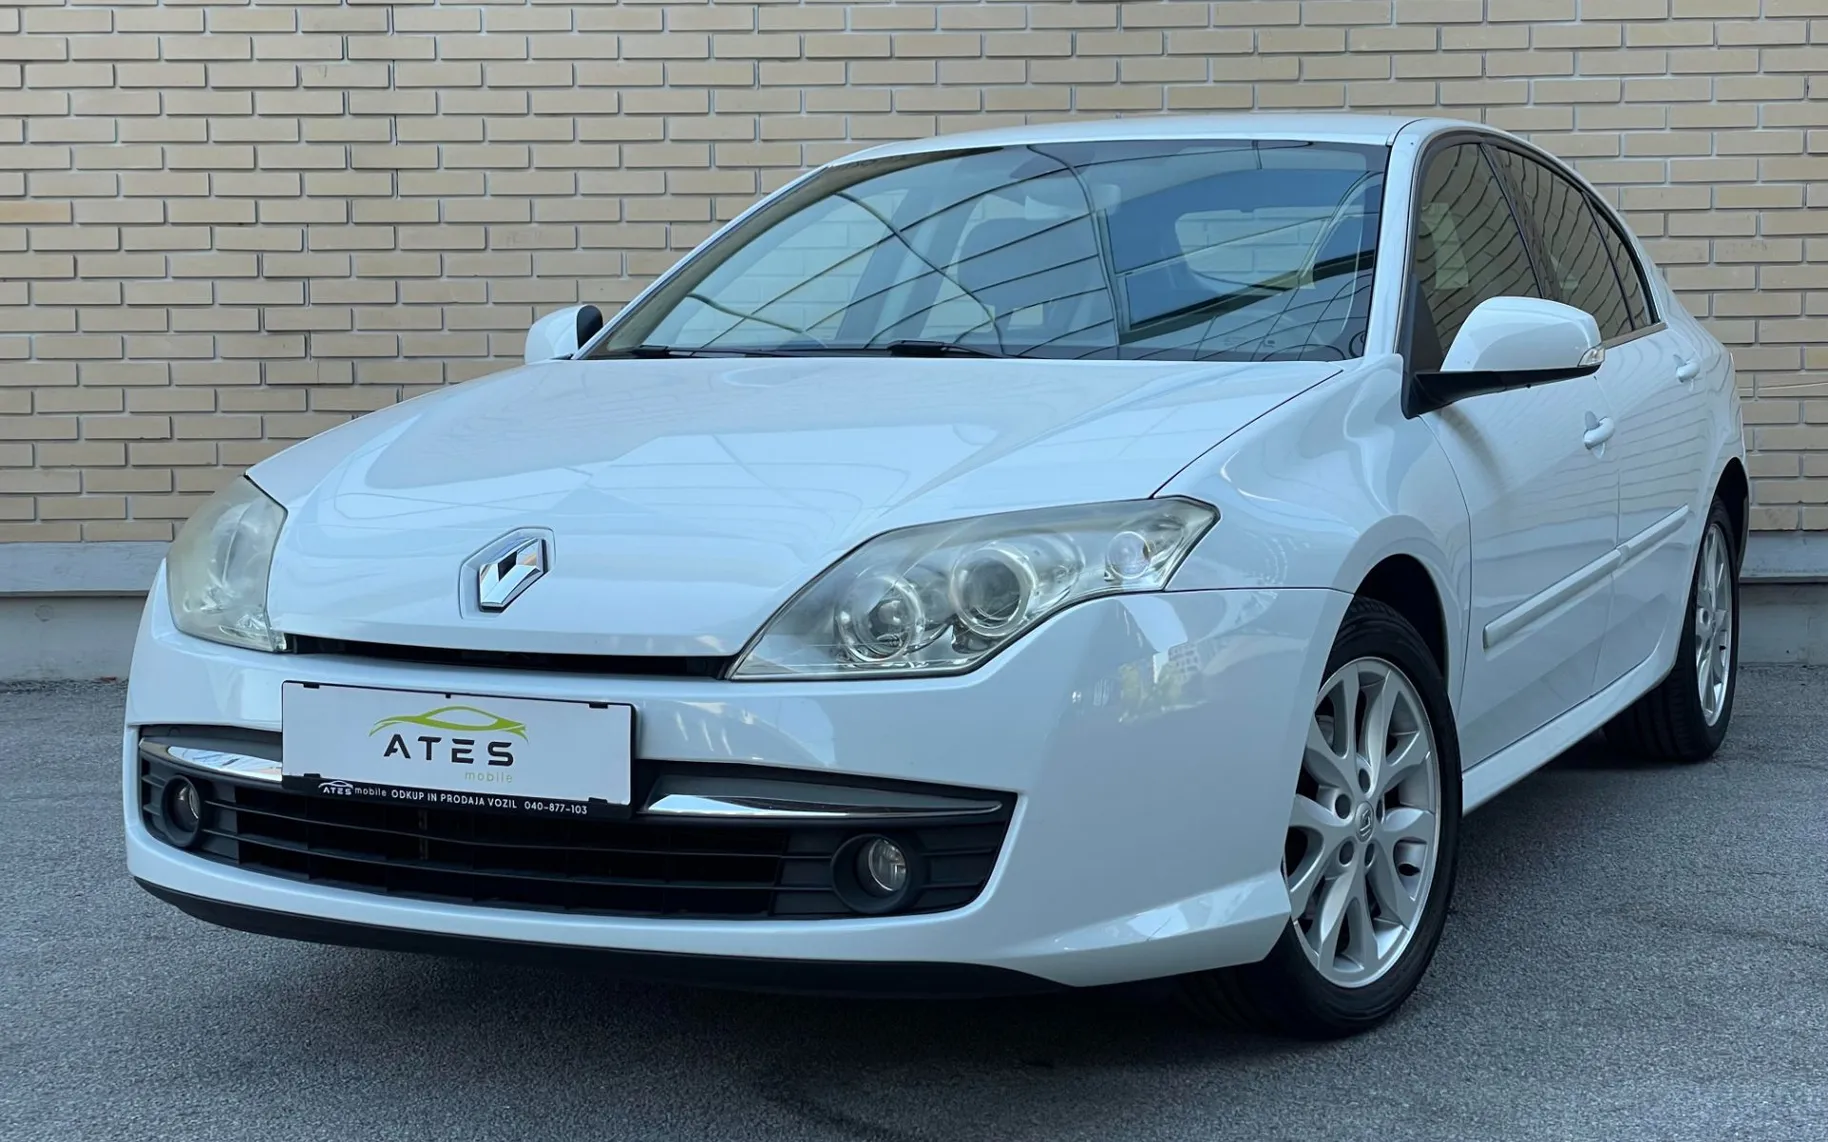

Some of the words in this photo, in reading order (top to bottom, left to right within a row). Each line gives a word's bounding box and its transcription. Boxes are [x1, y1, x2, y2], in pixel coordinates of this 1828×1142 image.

[383, 733, 514, 767] ATES
[464, 771, 513, 784] mobile
[322, 786, 352, 795] ATES
[354, 786, 387, 797] mobile
[391, 789, 424, 800] ODKUP
[427, 793, 437, 802] IN
[440, 793, 485, 806] PRODAJA
[487, 797, 517, 809] VOZIL
[524, 801, 588, 815] 040-877-103
